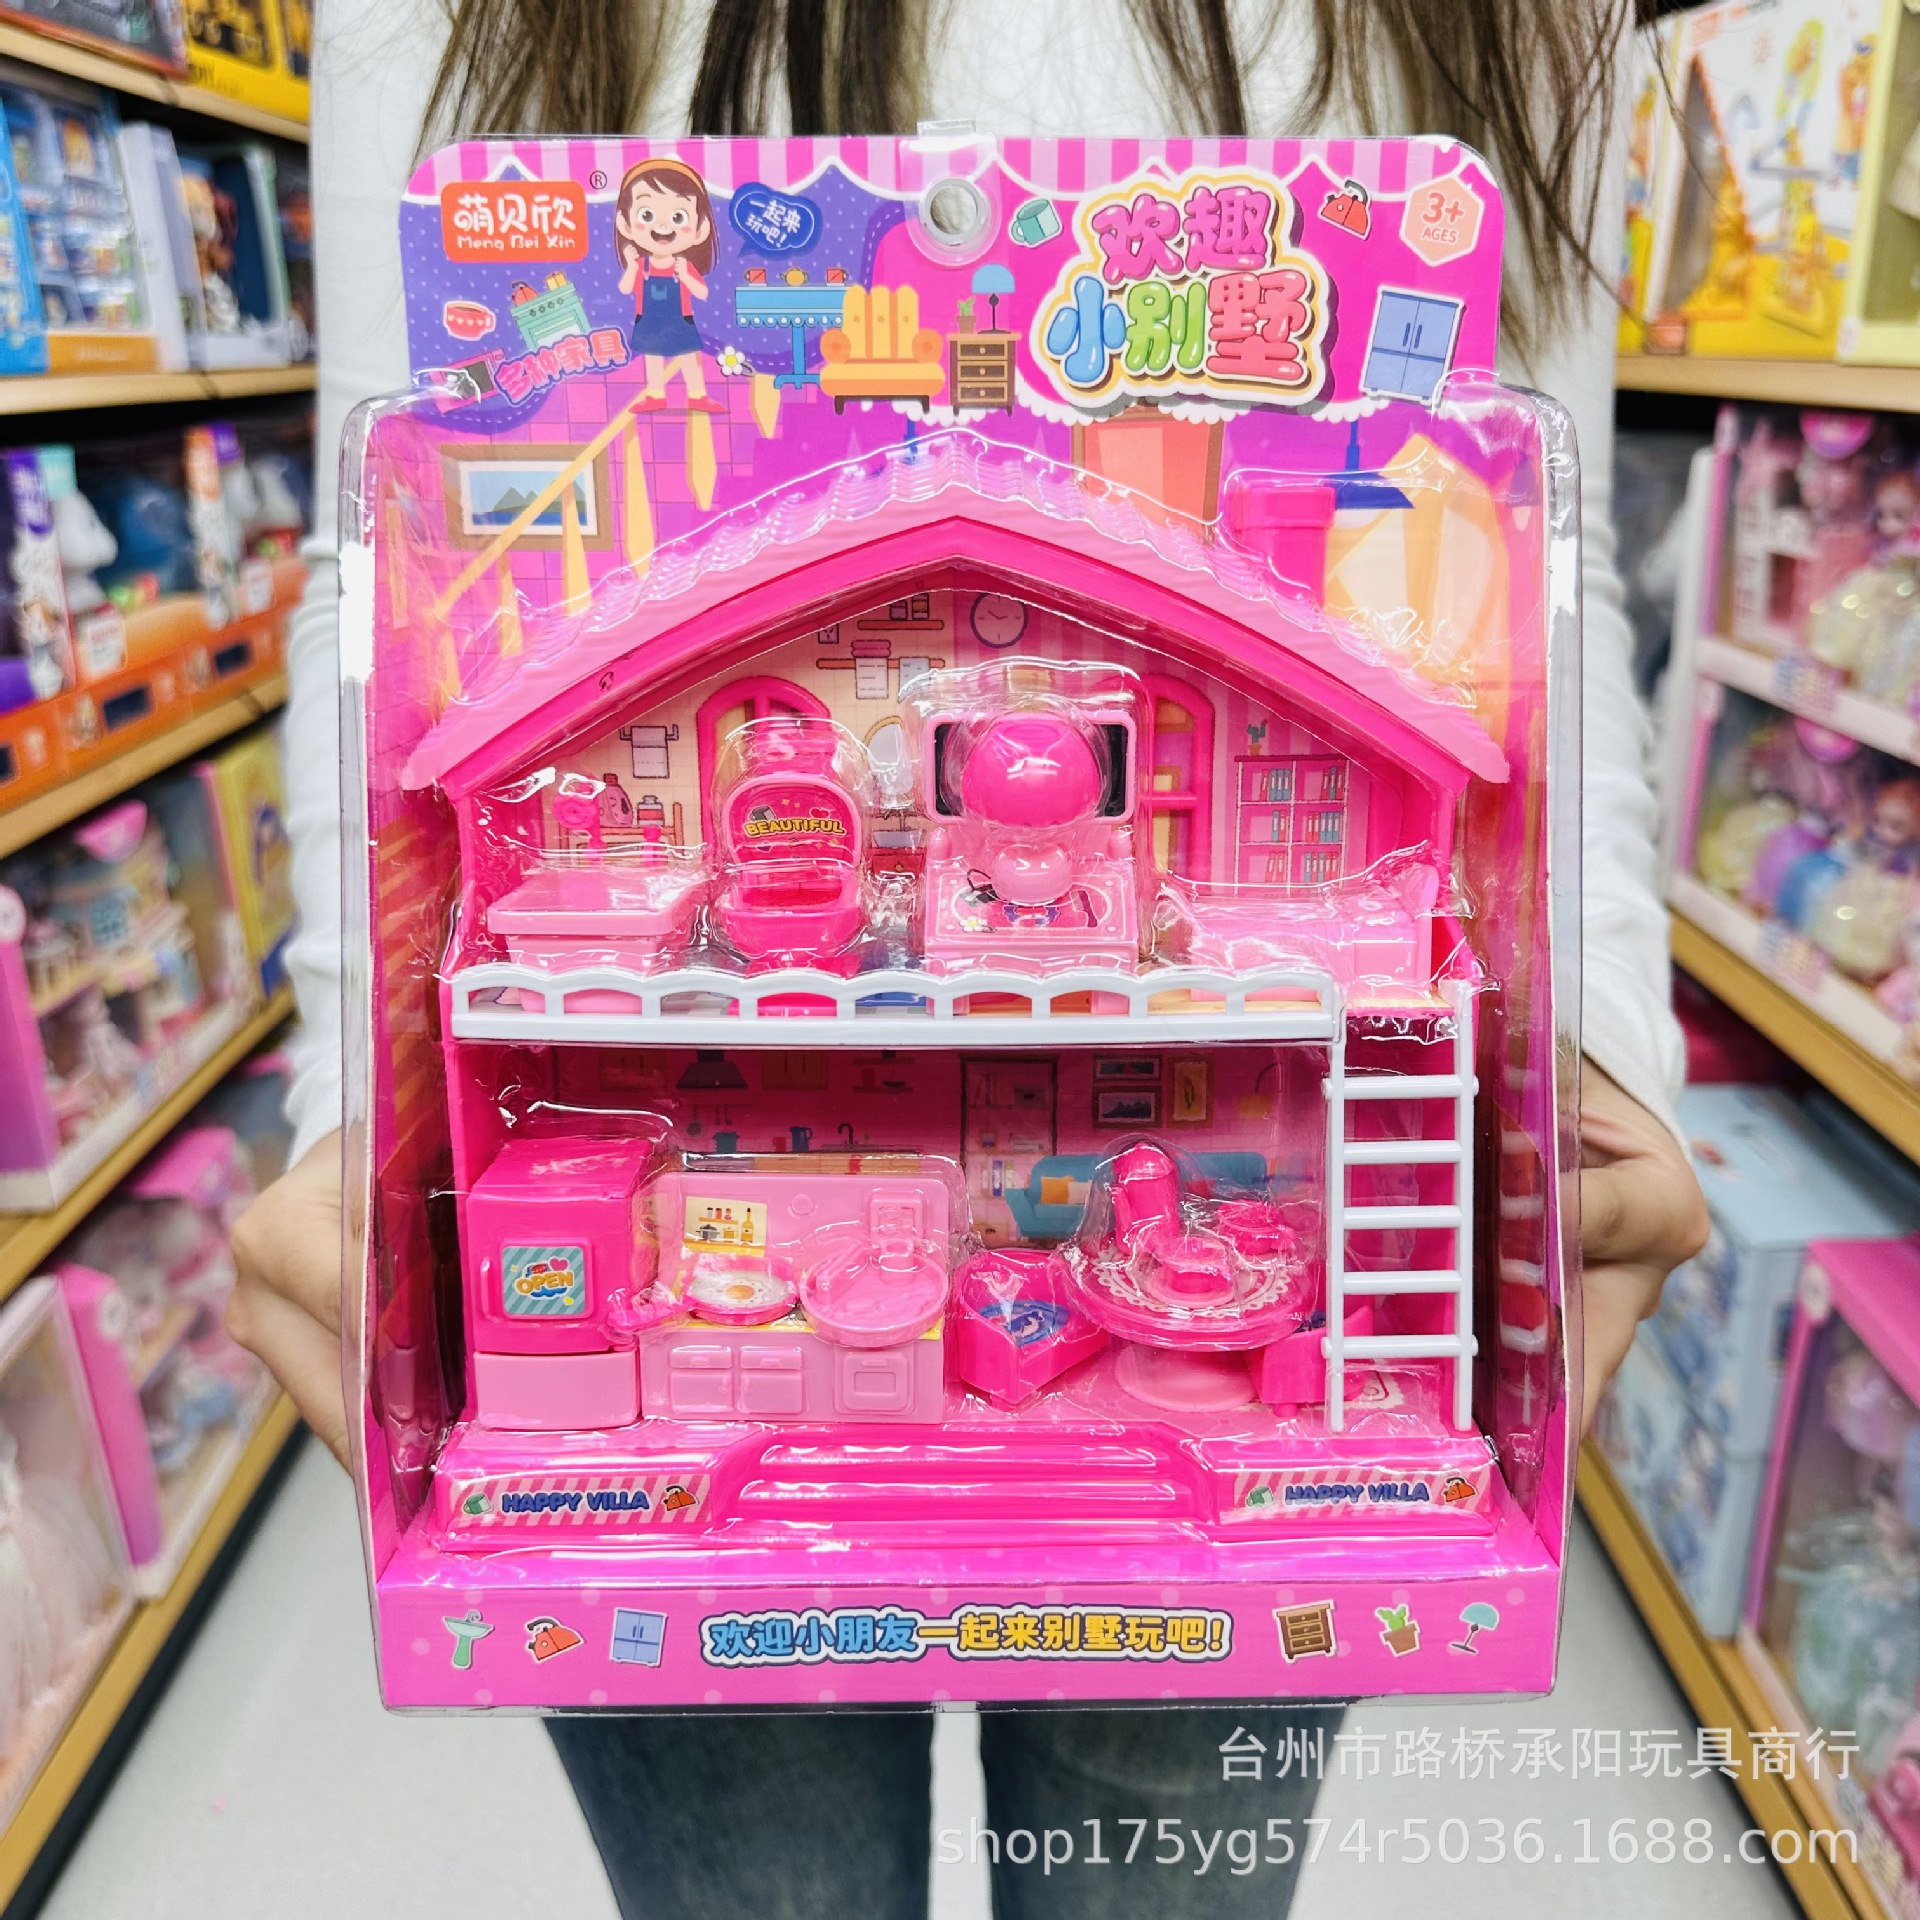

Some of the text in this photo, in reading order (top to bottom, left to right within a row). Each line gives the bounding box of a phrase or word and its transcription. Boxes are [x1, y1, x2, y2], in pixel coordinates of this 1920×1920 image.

[454, 193, 577, 235] 萌贝欣
[749, 199, 801, 233] 一起来
[1422, 191, 1464, 224] 3+
[457, 234, 576, 251] Meng Bei Xin
[1093, 186, 1271, 282] 欢趣
[1422, 227, 1458, 244] AGES
[1047, 271, 1308, 383] 小别墅
[496, 329, 629, 402] 多种家具
[743, 818, 846, 837] BEAUTIFUL
[515, 1270, 574, 1295] OPEN
[502, 1490, 650, 1513] HAPPY VILLA
[1284, 1482, 1430, 1506] HAPPY VILLA
[708, 1613, 1224, 1657] 欢迎小朋友一起来别墅玩吧!
